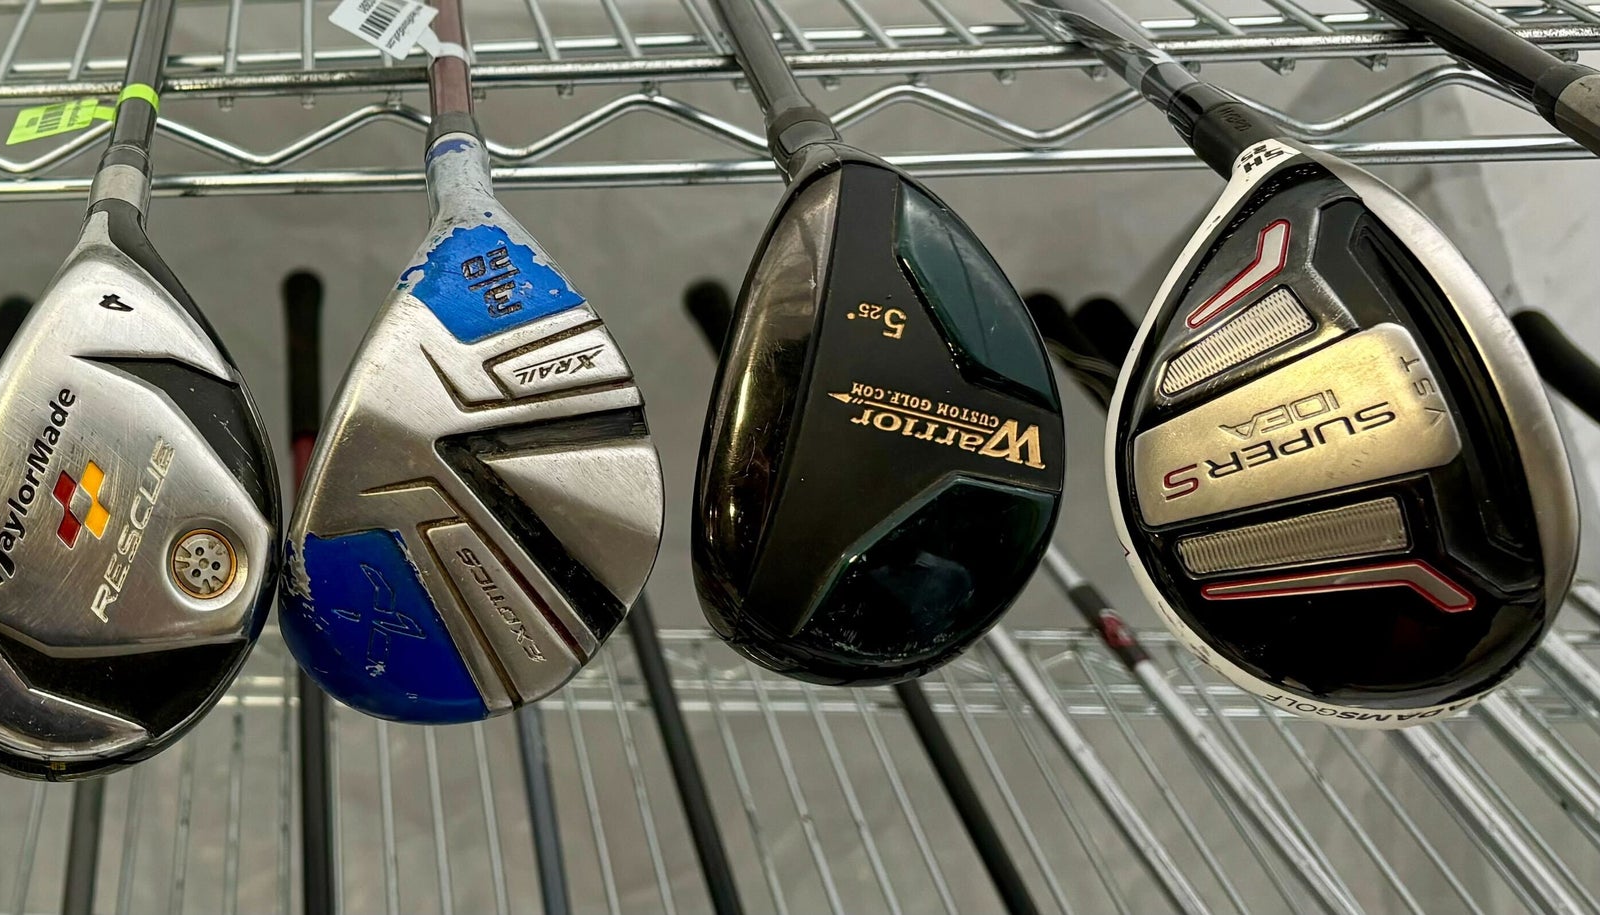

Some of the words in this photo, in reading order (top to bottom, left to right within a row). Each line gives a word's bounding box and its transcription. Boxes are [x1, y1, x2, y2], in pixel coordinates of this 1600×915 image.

[98, 293, 134, 312] 4
[850, 382, 932, 411] GOLF.COM
[935, 402, 1000, 427] CUSTOM
[1218, 388, 1341, 440] IDEA
[850, 408, 1046, 470] Warrior
[1203, 401, 1397, 479] SUPER
[1163, 463, 1199, 501] S
[90, 436, 176, 624] RESCUE
[456, 547, 548, 663] EXOTICS
